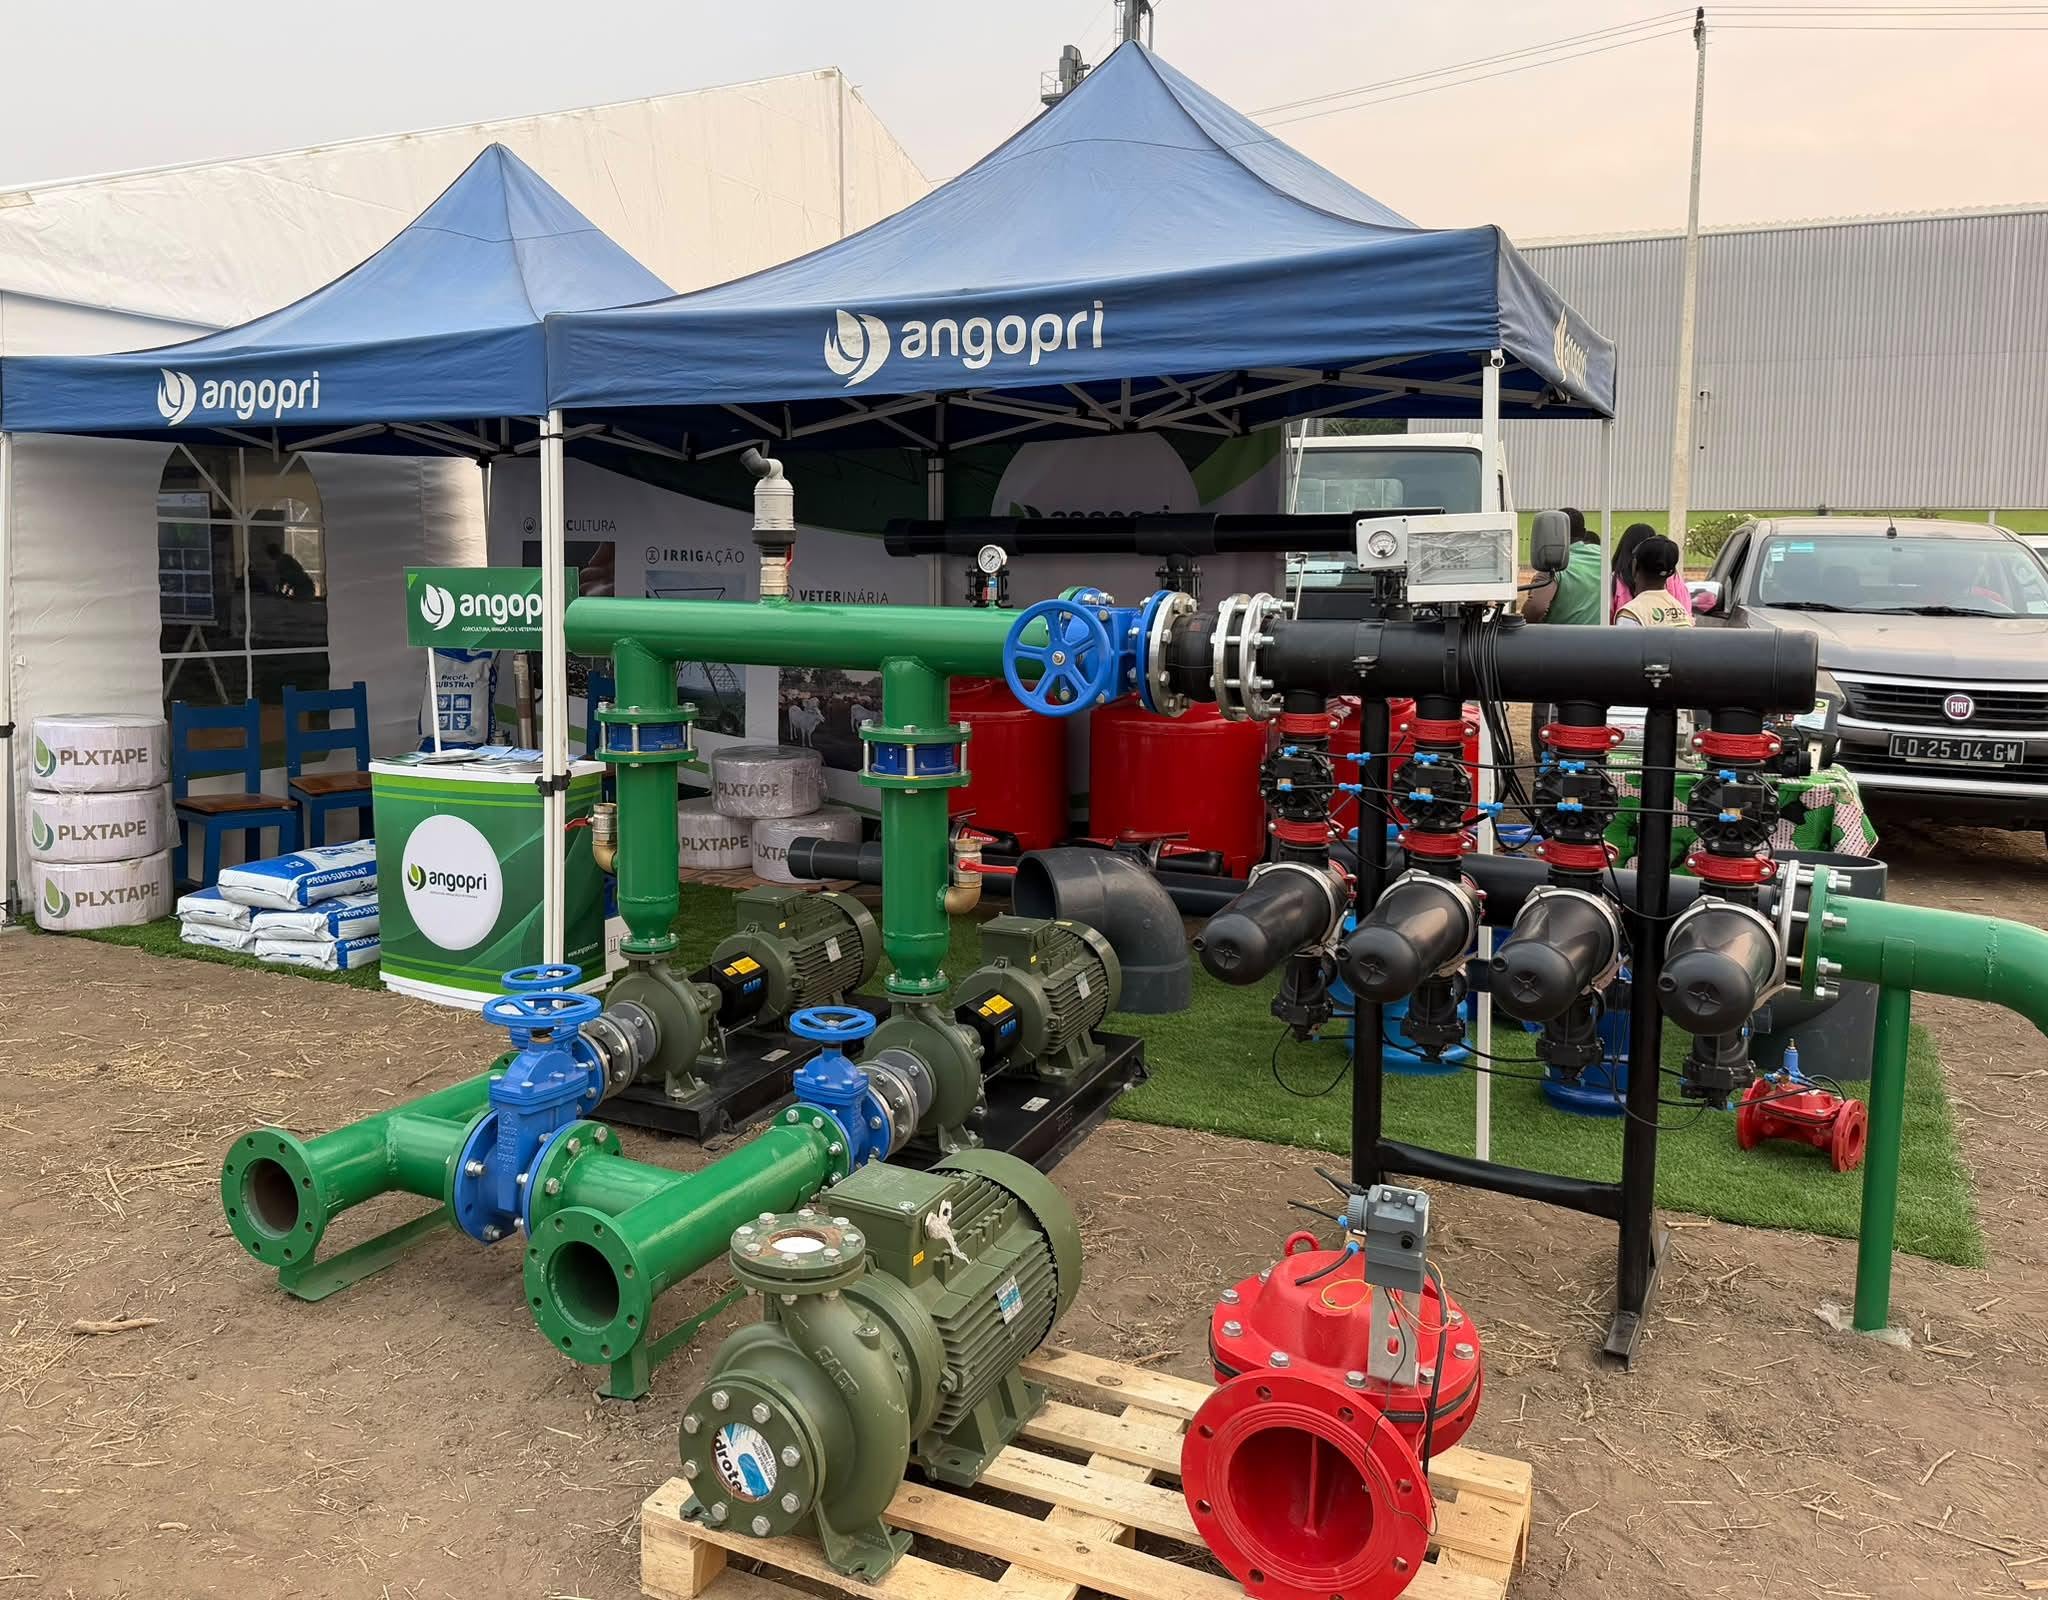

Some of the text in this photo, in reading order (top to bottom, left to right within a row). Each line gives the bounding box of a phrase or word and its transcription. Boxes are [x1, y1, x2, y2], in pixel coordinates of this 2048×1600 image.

[900, 300, 1104, 369] angopri
[202, 371, 319, 420] angopri
[566, 519, 616, 532] CULTURA
[663, 548, 745, 566] IRRIGAÇÃO
[800, 588, 889, 604] VETERINÁRIA
[459, 593, 542, 624] angop
[1951, 702, 1968, 713] FIAT
[60, 748, 148, 766] PLXTAPE
[718, 782, 780, 796] PLXTAPE
[58, 820, 147, 841] PLXTAPE
[682, 836, 748, 851] PLXTAPE
[756, 842, 788, 861] LXTA
[306, 867, 368, 886] PROFI-SUBSTRAT
[429, 872, 487, 893] angopri
[75, 882, 160, 908] PLXTAPE
[336, 903, 380, 920] PROFI-SUB
